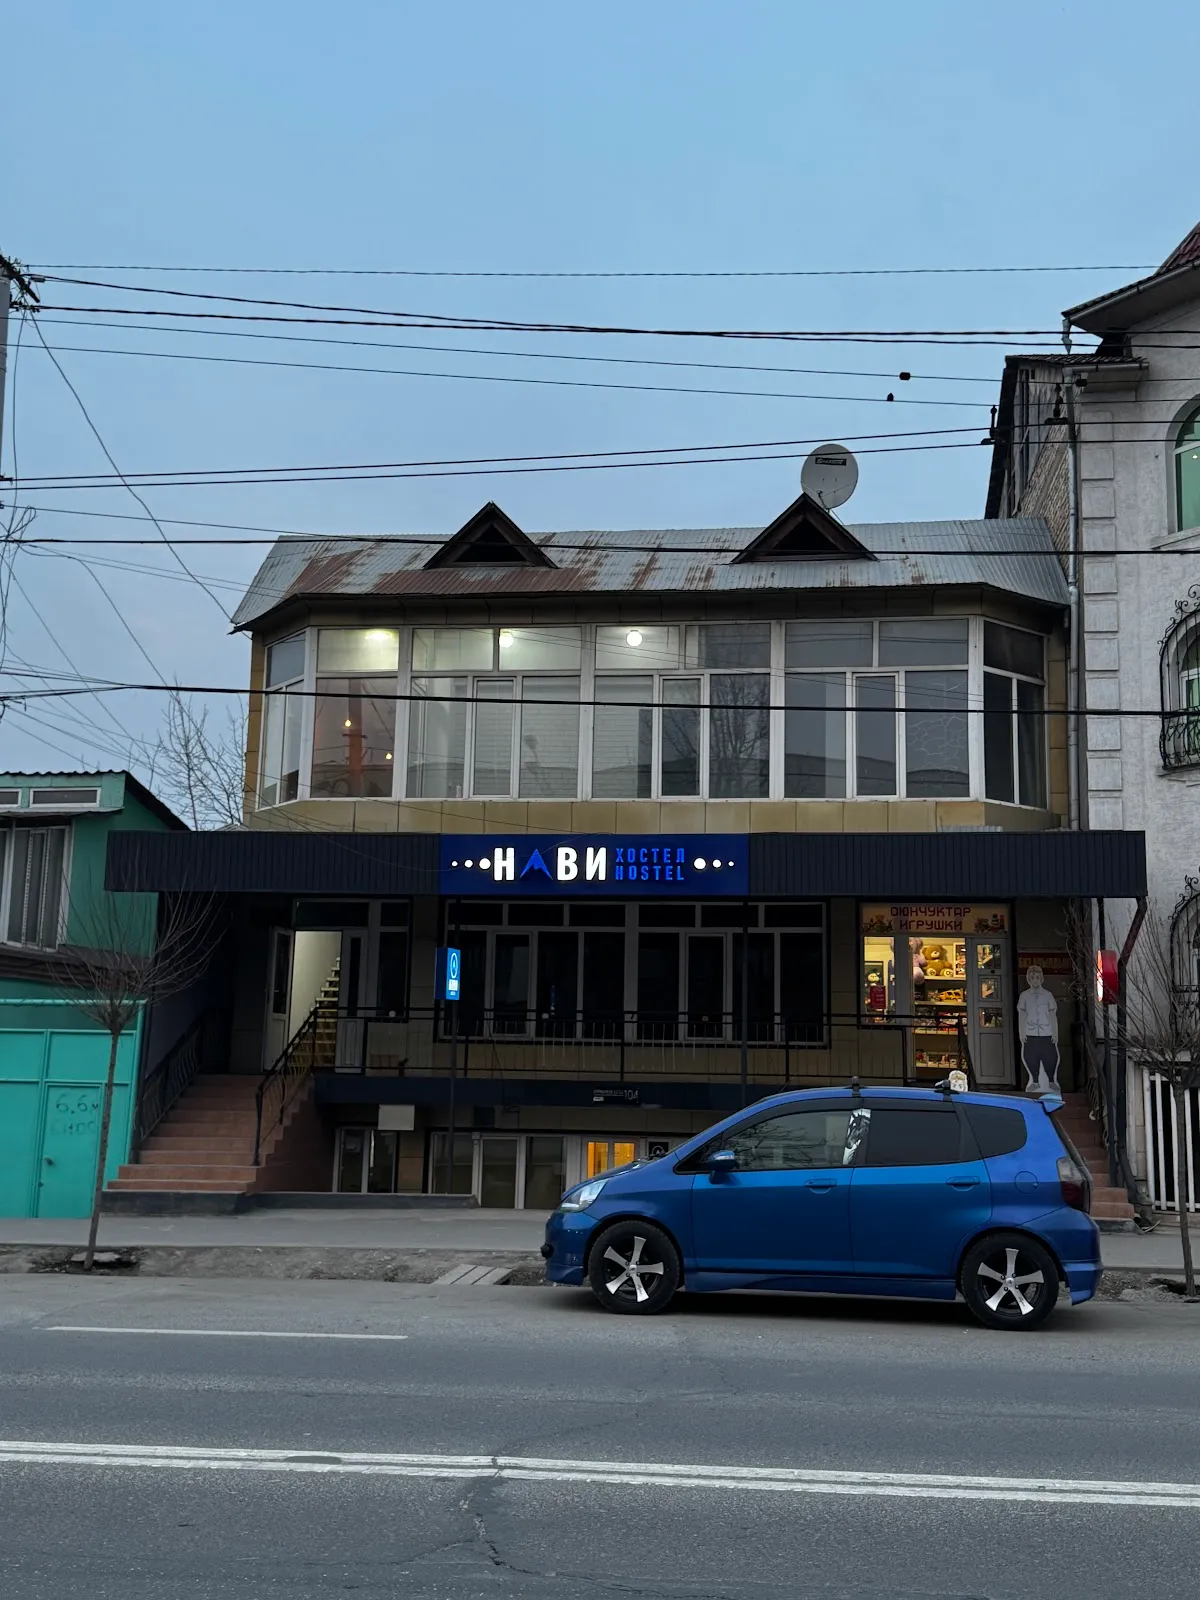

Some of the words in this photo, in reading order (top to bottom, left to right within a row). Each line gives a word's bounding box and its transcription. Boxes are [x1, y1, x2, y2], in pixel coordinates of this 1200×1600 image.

[615, 847, 685, 863] ХОСТЕЛ
[615, 865, 685, 881] HOSTEL
[890, 906, 971, 917] ОЮНЧУКТАР
[899, 919, 963, 931] ИГРУШКИ
[624, 1089, 639, 1100] 104
